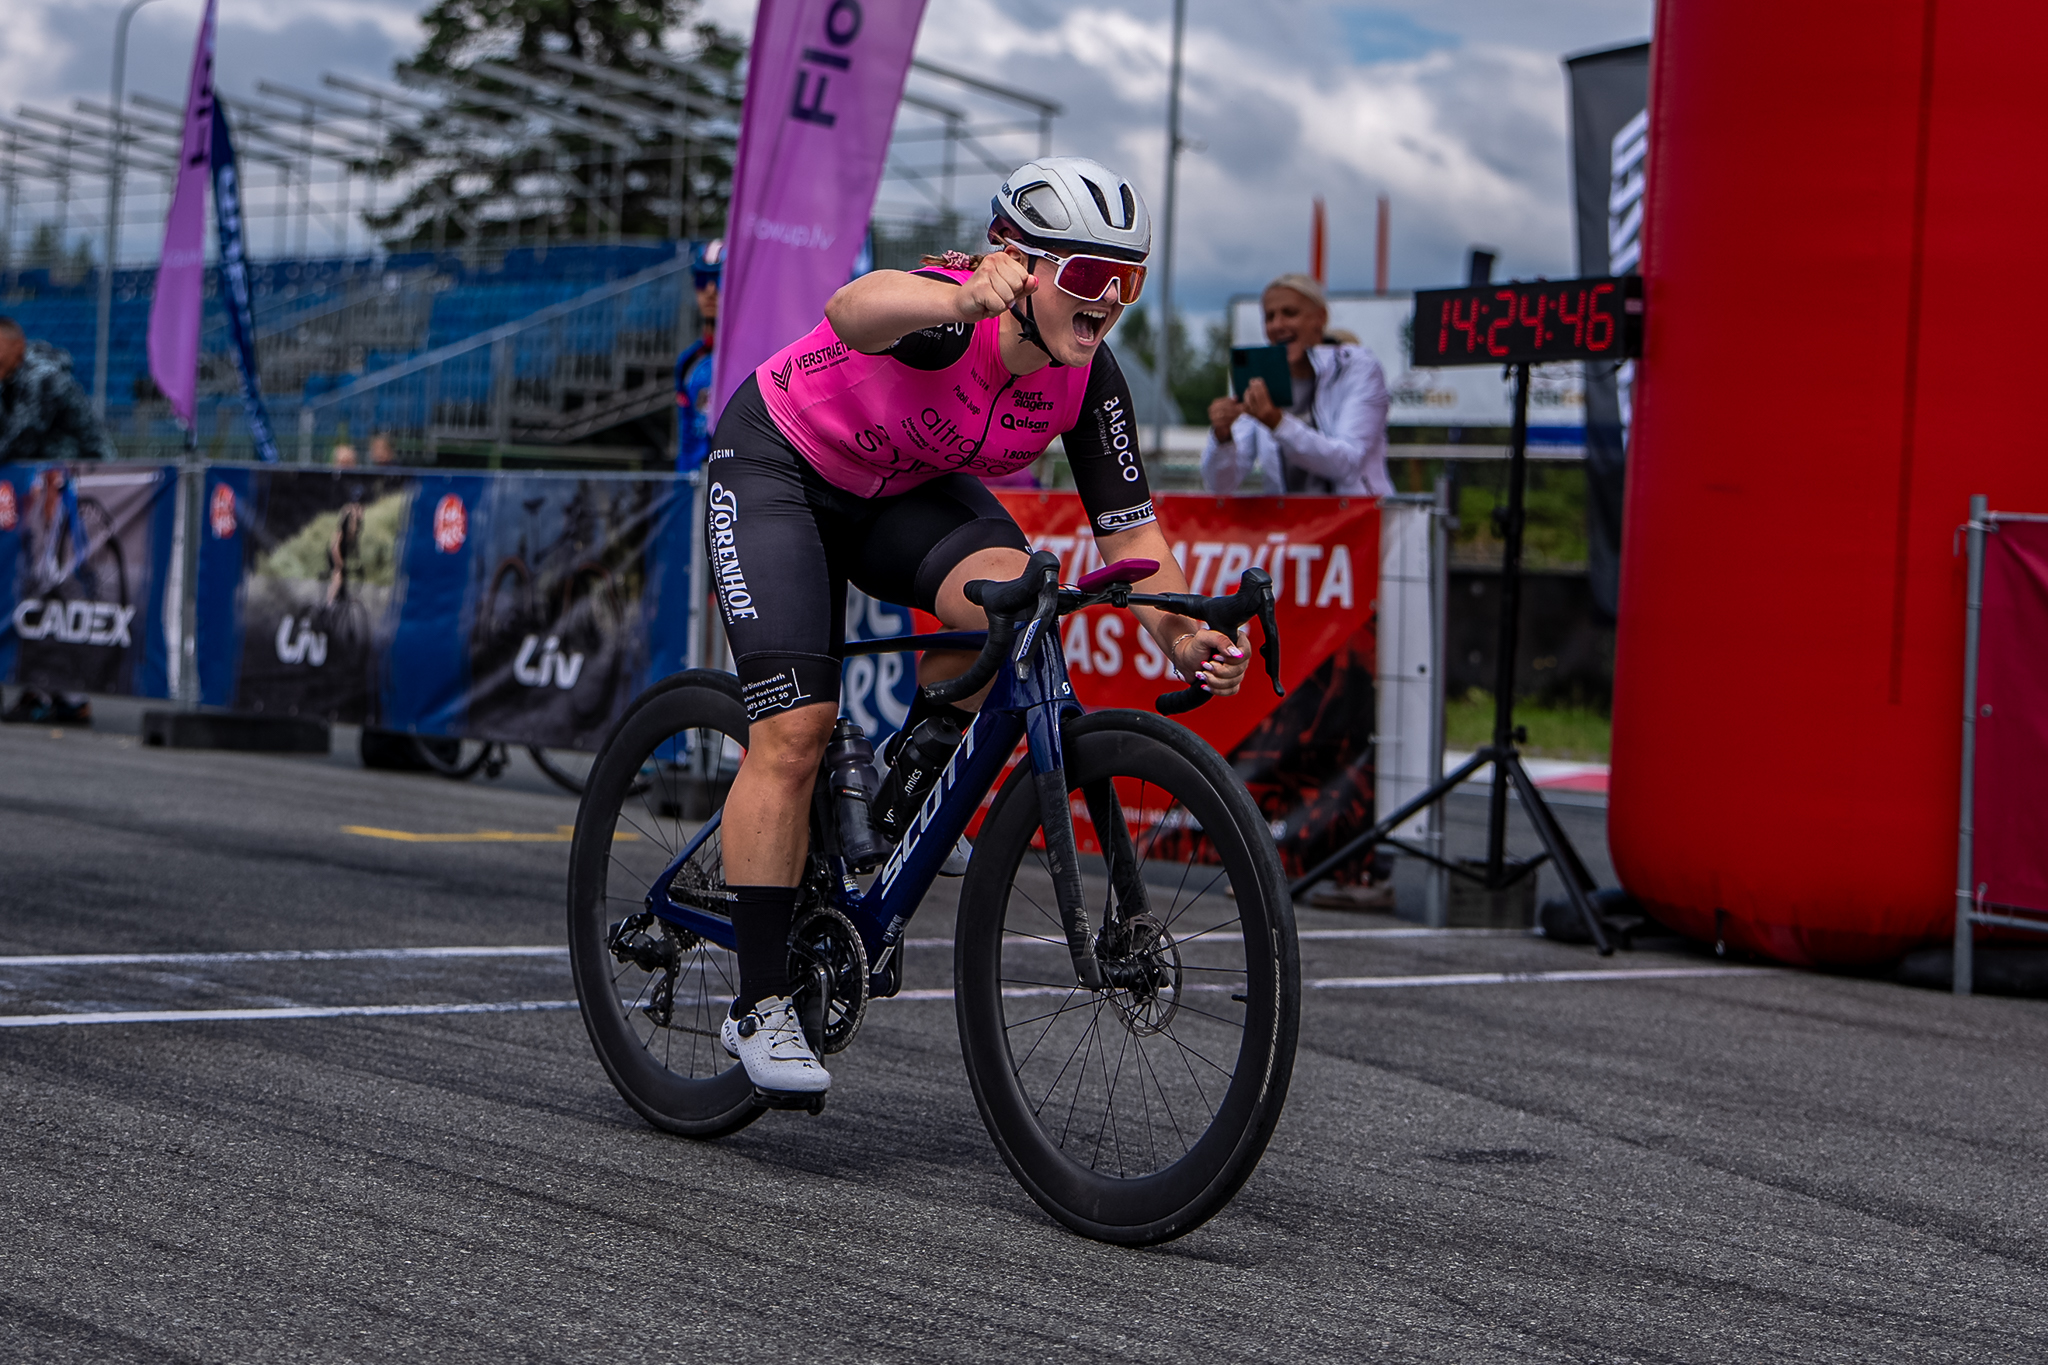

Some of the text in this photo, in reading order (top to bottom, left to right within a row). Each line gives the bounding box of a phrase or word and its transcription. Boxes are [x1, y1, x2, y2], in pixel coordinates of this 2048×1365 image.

[1438, 283, 1616, 357] 14:24:46
[795, 341, 852, 371] VERSTRAET
[1014, 398, 1054, 412] slagers
[709, 481, 759, 620] TORENHOF
[12, 600, 136, 647] CADEX
[275, 614, 328, 667] Liv
[513, 633, 584, 690] Liv
[881, 712, 980, 900] SCOTT
